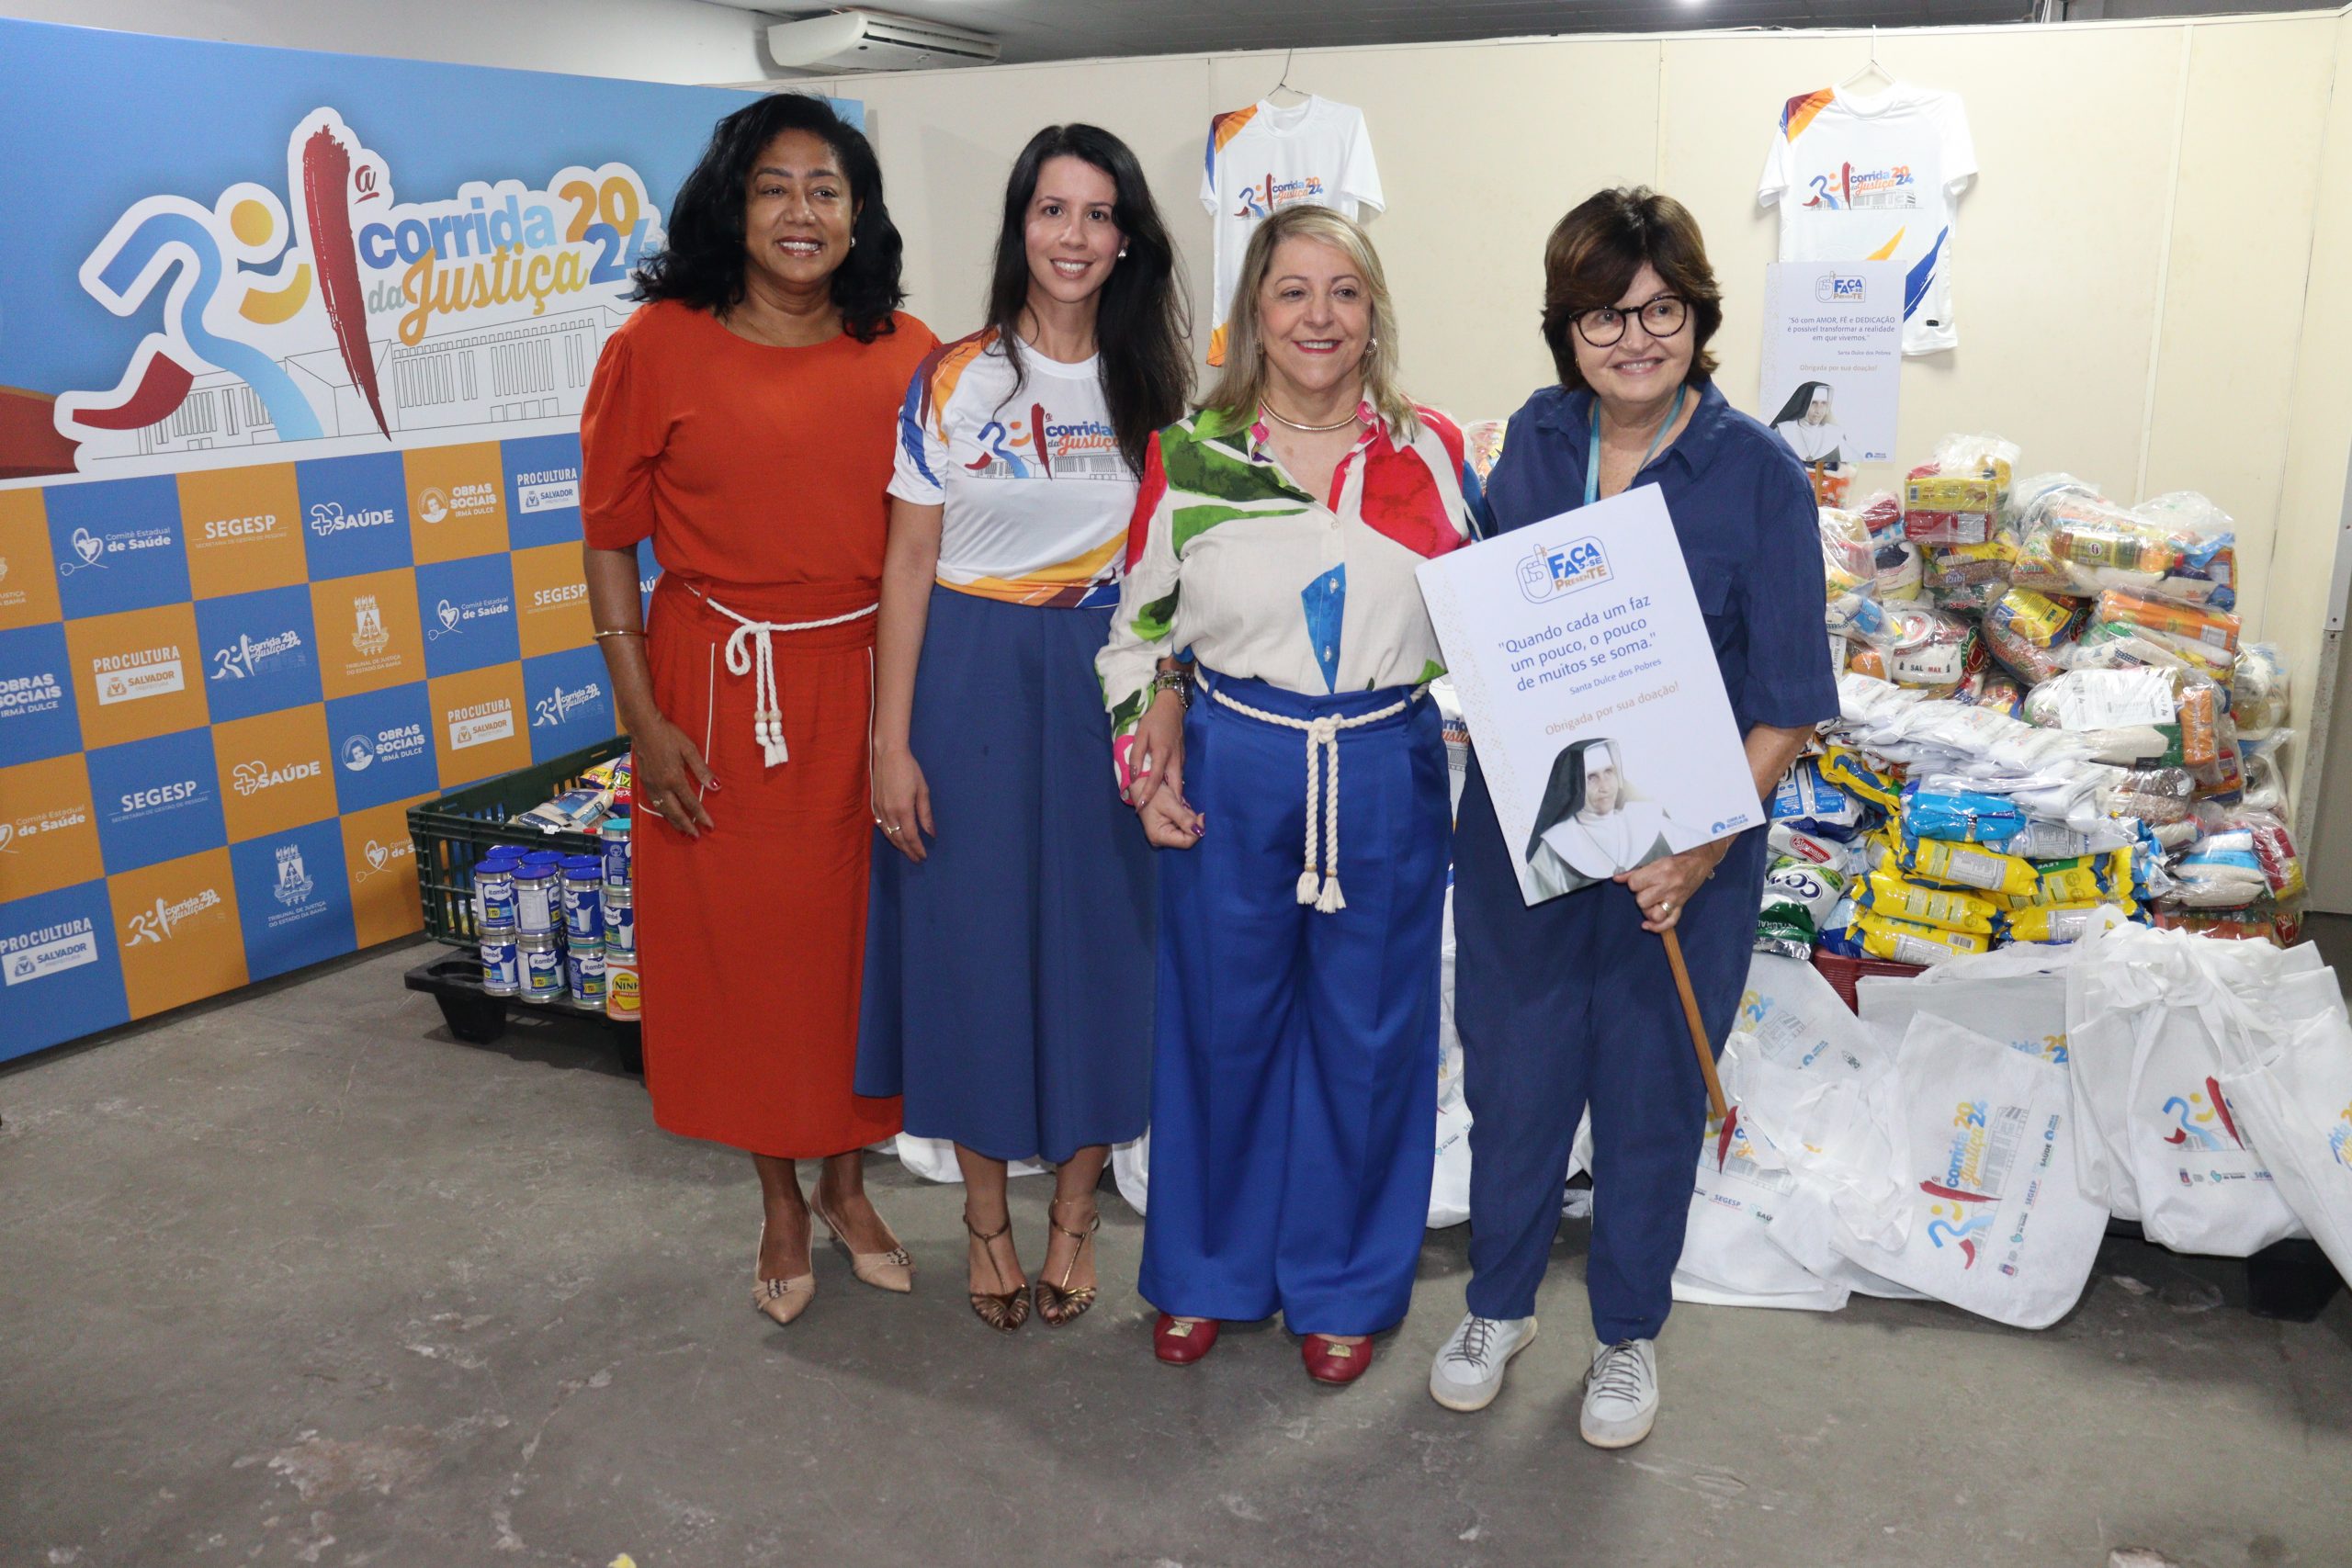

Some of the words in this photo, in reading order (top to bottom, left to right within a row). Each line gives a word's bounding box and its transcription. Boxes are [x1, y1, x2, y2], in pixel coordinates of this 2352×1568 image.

[1850, 170, 1890, 184] corrida
[1891, 164, 1909, 178] 20
[1272, 180, 1305, 193] corrida
[1305, 176, 1322, 186] 20
[1855, 178, 1895, 197] Justiça
[1895, 174, 1915, 186] 24
[359, 196, 557, 269] corrida
[559, 175, 640, 243] 20
[368, 280, 407, 315] da
[398, 243, 590, 346] Justiça
[1834, 279, 1862, 294] FAÇA
[1793, 325, 1818, 334] possível
[1864, 324, 1895, 333] realidade
[1839, 315, 1848, 323] FÉ
[1855, 315, 1895, 325] DEDICAÇÃO
[1046, 421, 1116, 437] corrida
[1047, 439, 1060, 448] da
[516, 468, 578, 486] PROCULTURA
[452, 482, 492, 497] OBRAS
[540, 488, 573, 501] SALVADOR
[449, 493, 497, 510] SOCIAIS
[334, 509, 395, 531] SAÚDE
[455, 508, 472, 518] IRMÃ
[473, 506, 494, 516] DULCE
[105, 530, 136, 542] Comitê
[137, 526, 171, 538] Estadual
[204, 514, 277, 540] SEGESP
[107, 541, 126, 553] de
[129, 536, 172, 551] Saúde
[1547, 543, 1600, 581] FAÇA
[460, 600, 483, 611] Comitê
[483, 595, 509, 606] Estadual
[534, 583, 588, 606] SEGESP
[462, 610, 476, 620] de
[478, 604, 509, 617] Saúde
[1498, 626, 1563, 653] "Quando
[1566, 613, 1600, 633] cada
[1603, 604, 1626, 621] um
[1629, 595, 1652, 611] faz
[1510, 657, 1535, 672] um
[1538, 639, 1587, 667] pouco,
[1589, 635, 1600, 646] o
[1603, 617, 1647, 645] pouco
[93, 645, 181, 673] PROCULTURA
[1517, 677, 1535, 692] de
[1539, 660, 1588, 685] muitos
[1590, 653, 1607, 667] se
[1610, 631, 1657, 660] soma."
[0, 673, 55, 694] OBRAS
[128, 670, 175, 687] SALVADOR
[1569, 682, 1593, 695] Santa
[1593, 673, 1617, 688] Dulce
[1618, 667, 1634, 679] dos
[1634, 658, 1662, 674] Pobres
[1, 704, 26, 718] IRMÃ
[28, 701, 60, 715] DULCE
[447, 697, 512, 723] PROCULTURA
[1545, 712, 1594, 737] Obrigada
[1595, 705, 1614, 721] por
[1616, 698, 1636, 712] sua
[1637, 681, 1680, 705] doação!
[378, 723, 421, 742] OBRAS
[472, 719, 508, 735] SALVADOR
[375, 734, 425, 755] SOCIAIS
[381, 752, 400, 763] IRMÃ
[401, 746, 423, 760] DULCE
[257, 760, 322, 788] SAÚDE
[120, 780, 198, 813] SEGESP
[16, 813, 48, 827] Comitê
[48, 804, 85, 819] Estadual
[17, 824, 38, 837] de
[40, 813, 85, 833] Saúde
[390, 849, 405, 859] de
[267, 910, 296, 922] TRIBUNAL
[304, 900, 327, 912] JUSTIÇA
[278, 915, 301, 926] ESTADO
[0, 917, 93, 955] PROCULTURA
[36, 942, 87, 964] SALVADOR
[2052, 1045, 2069, 1065] 2
[1713, 1194, 1741, 1207] SEGESP
